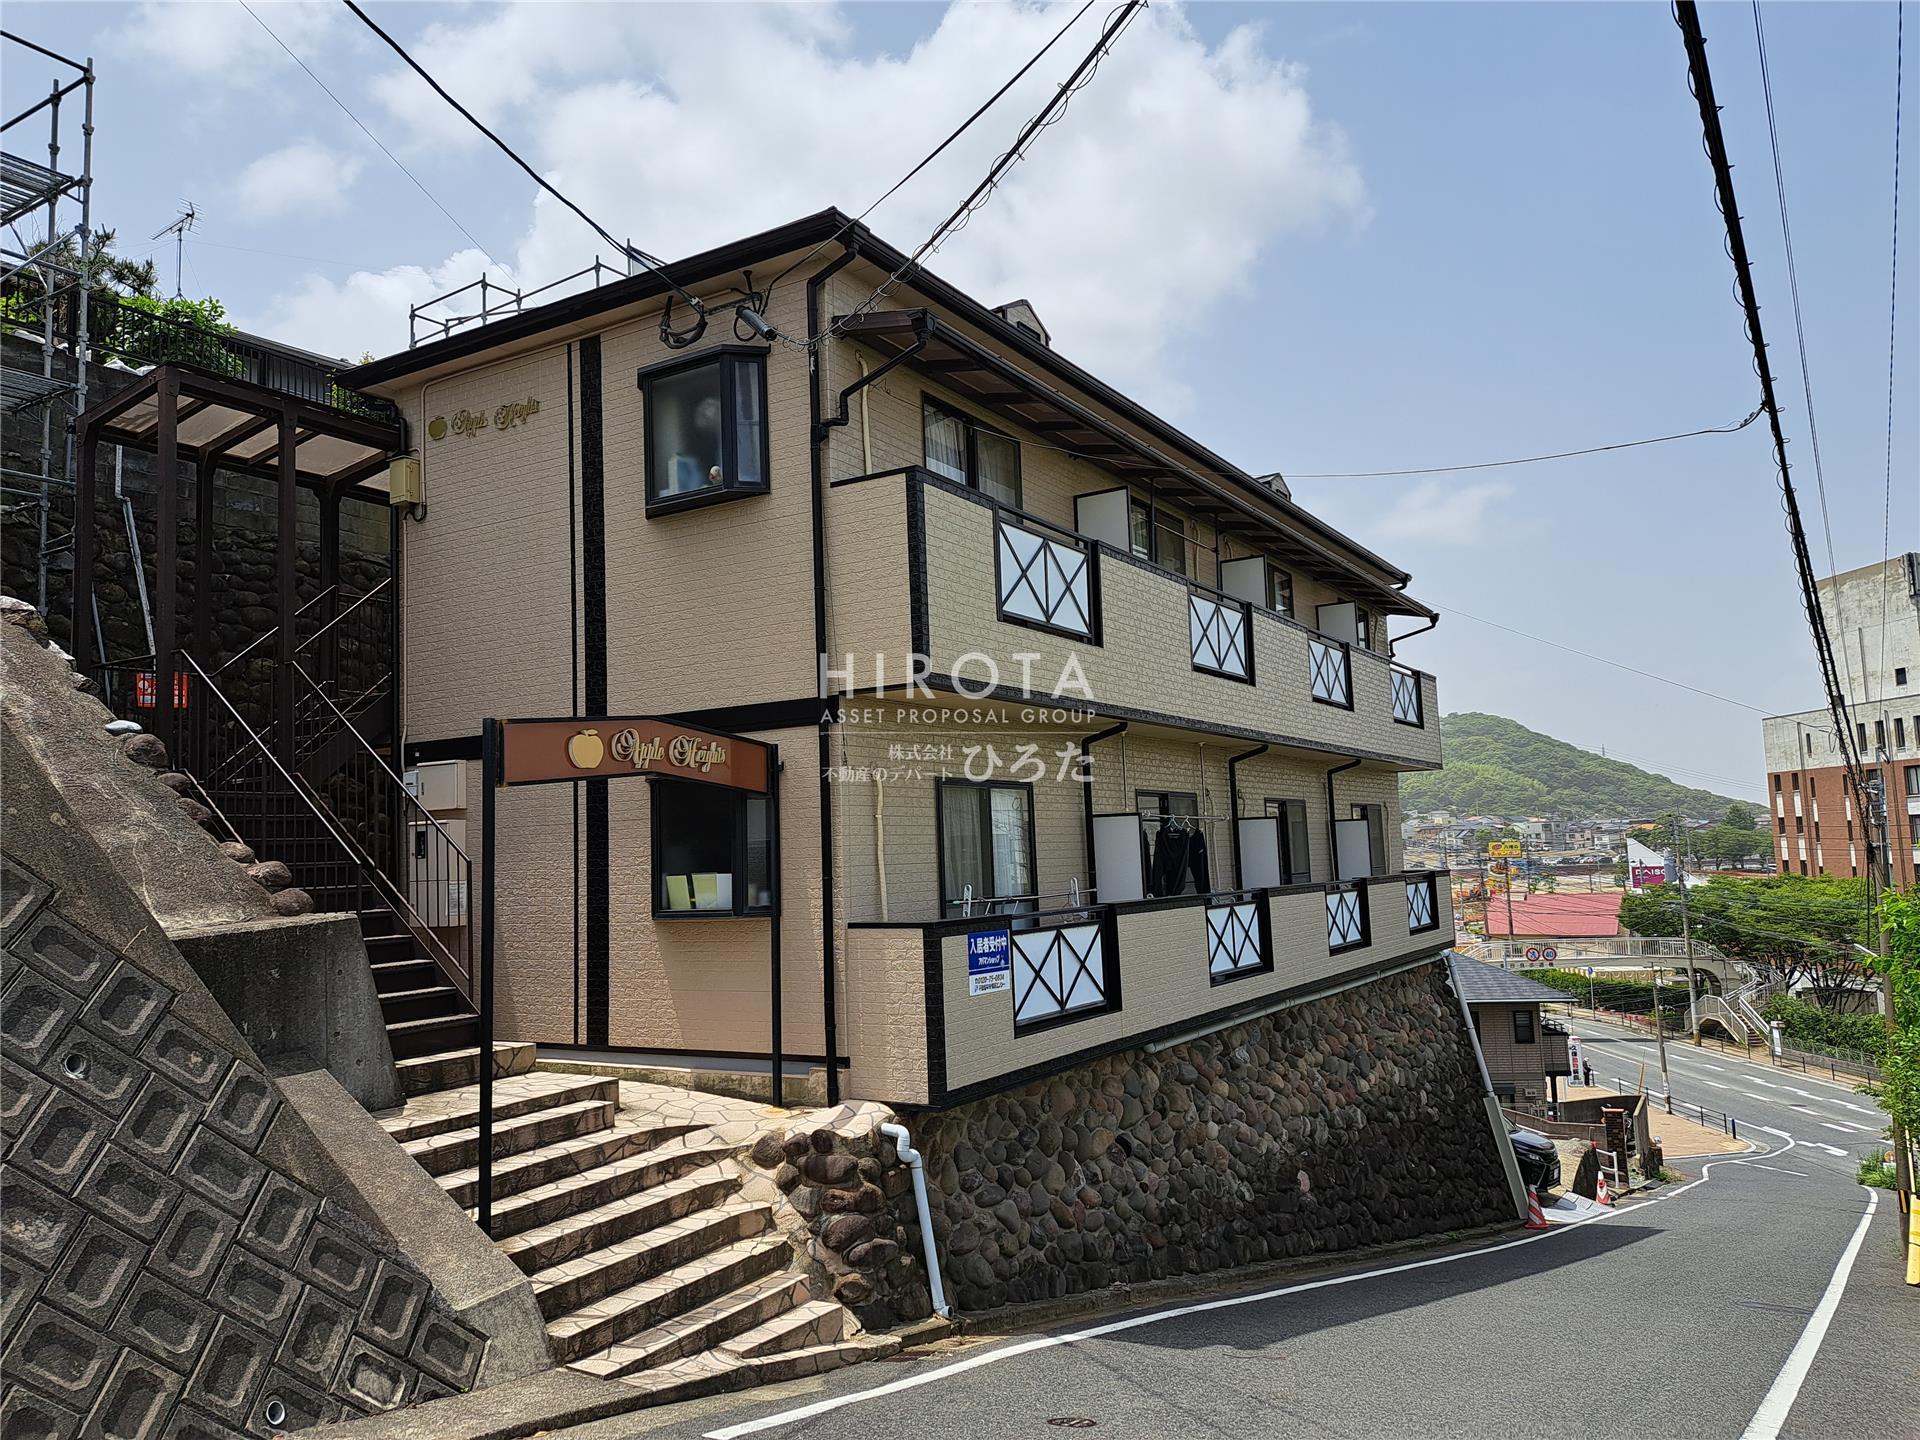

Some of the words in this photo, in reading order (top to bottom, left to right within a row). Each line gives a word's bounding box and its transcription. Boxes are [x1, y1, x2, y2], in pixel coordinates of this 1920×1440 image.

[611, 728, 665, 769] Apple
[668, 734, 728, 773] Heights
[970, 935, 1007, 954] 入居者受付中
